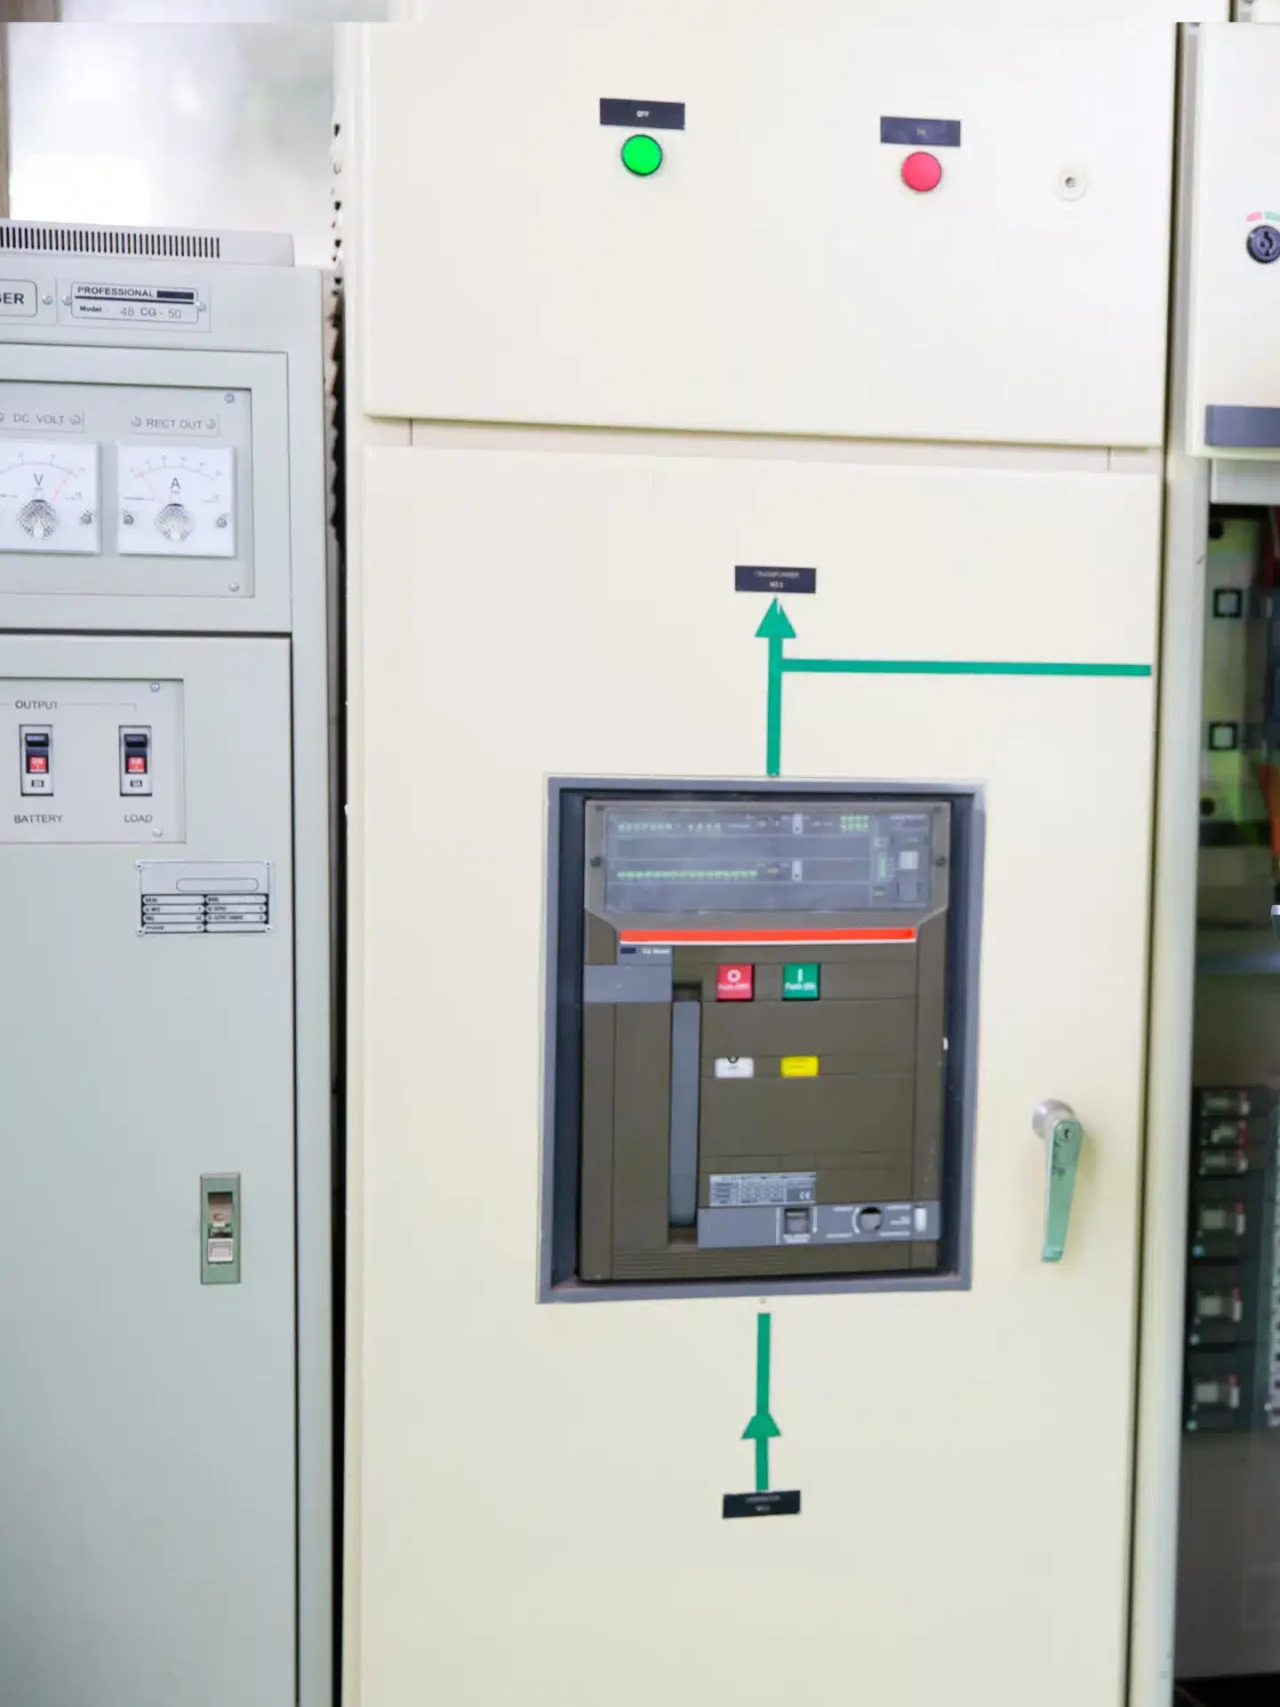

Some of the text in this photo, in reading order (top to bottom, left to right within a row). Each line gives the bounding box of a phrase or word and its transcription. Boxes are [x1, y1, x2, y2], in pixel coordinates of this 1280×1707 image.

[77, 286, 155, 297] PROFESSIONAL
[0, 292, 25, 305] ER
[36, 414, 65, 425] VOLT
[146, 418, 203, 430] RECT OUT
[33, 473, 44, 486] V
[170, 476, 181, 490] A
[14, 700, 58, 710] OUTPUT
[14, 814, 63, 824] BATTERY
[123, 814, 153, 823] LOAD
